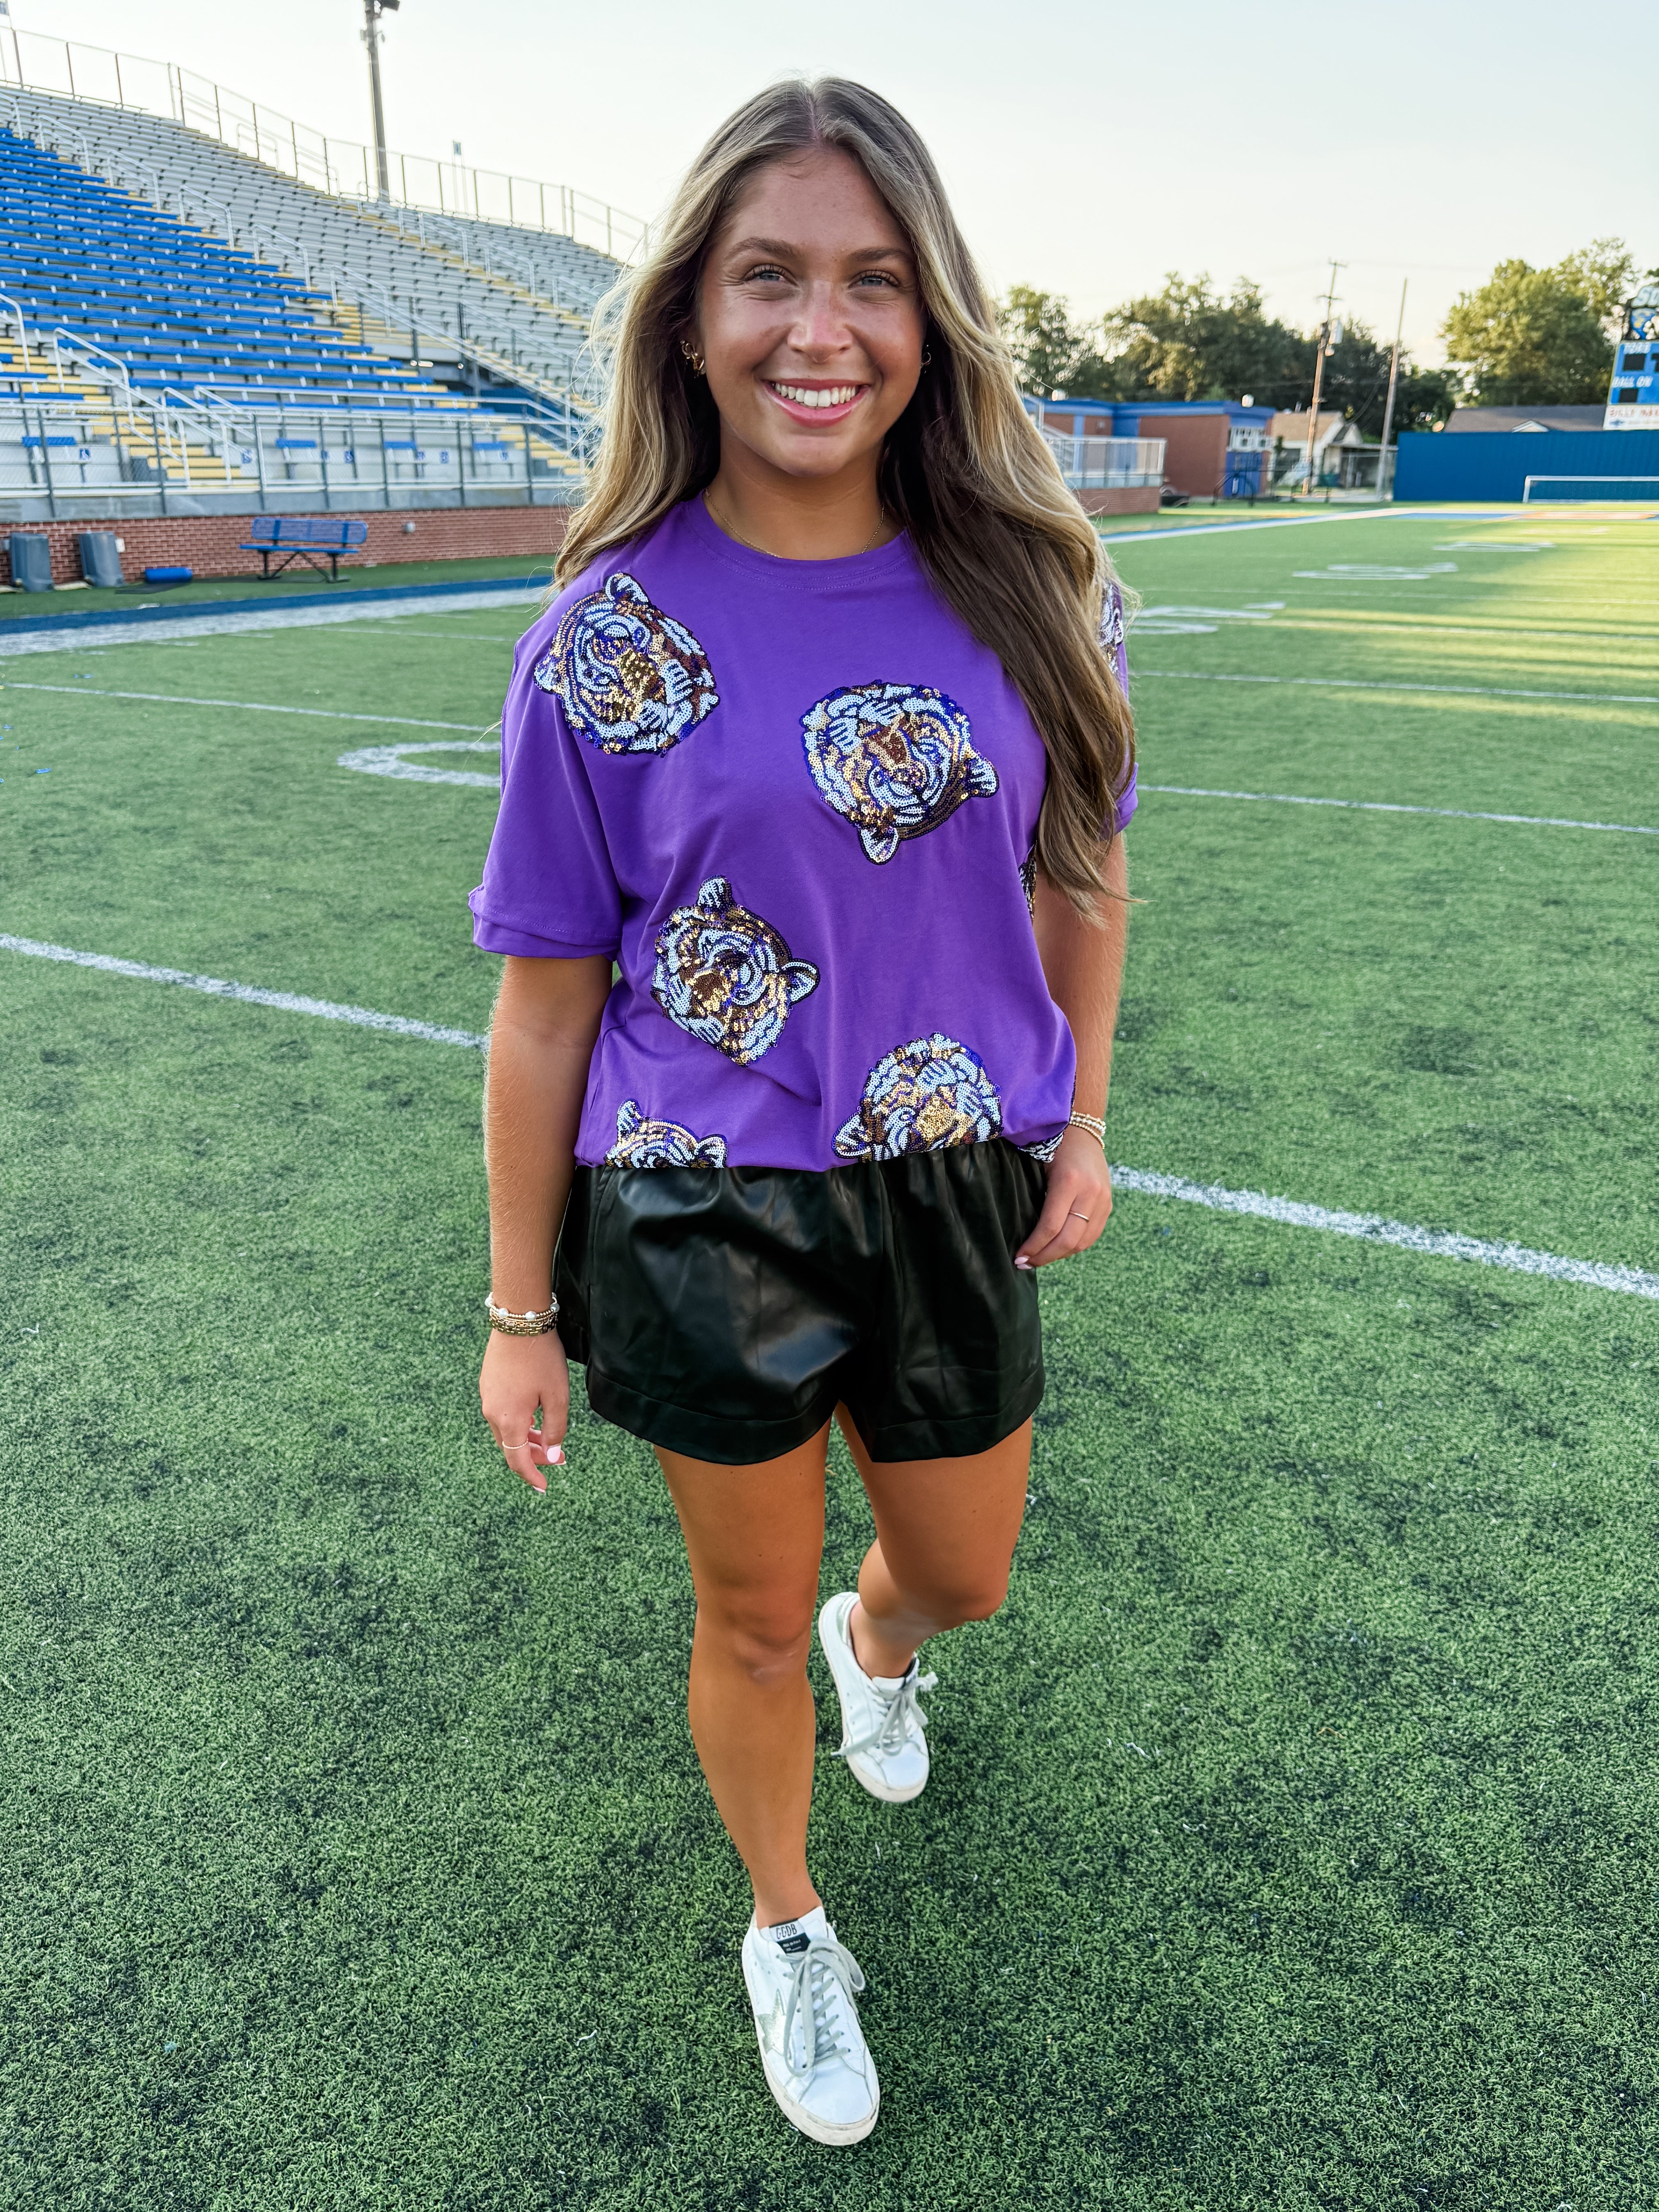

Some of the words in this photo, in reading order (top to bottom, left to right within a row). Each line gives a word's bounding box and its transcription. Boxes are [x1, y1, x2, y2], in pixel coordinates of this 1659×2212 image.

[1611, 376, 1635, 388] BALL
[1636, 375, 1653, 387] ON
[776, 1924, 797, 1939] GGDB
